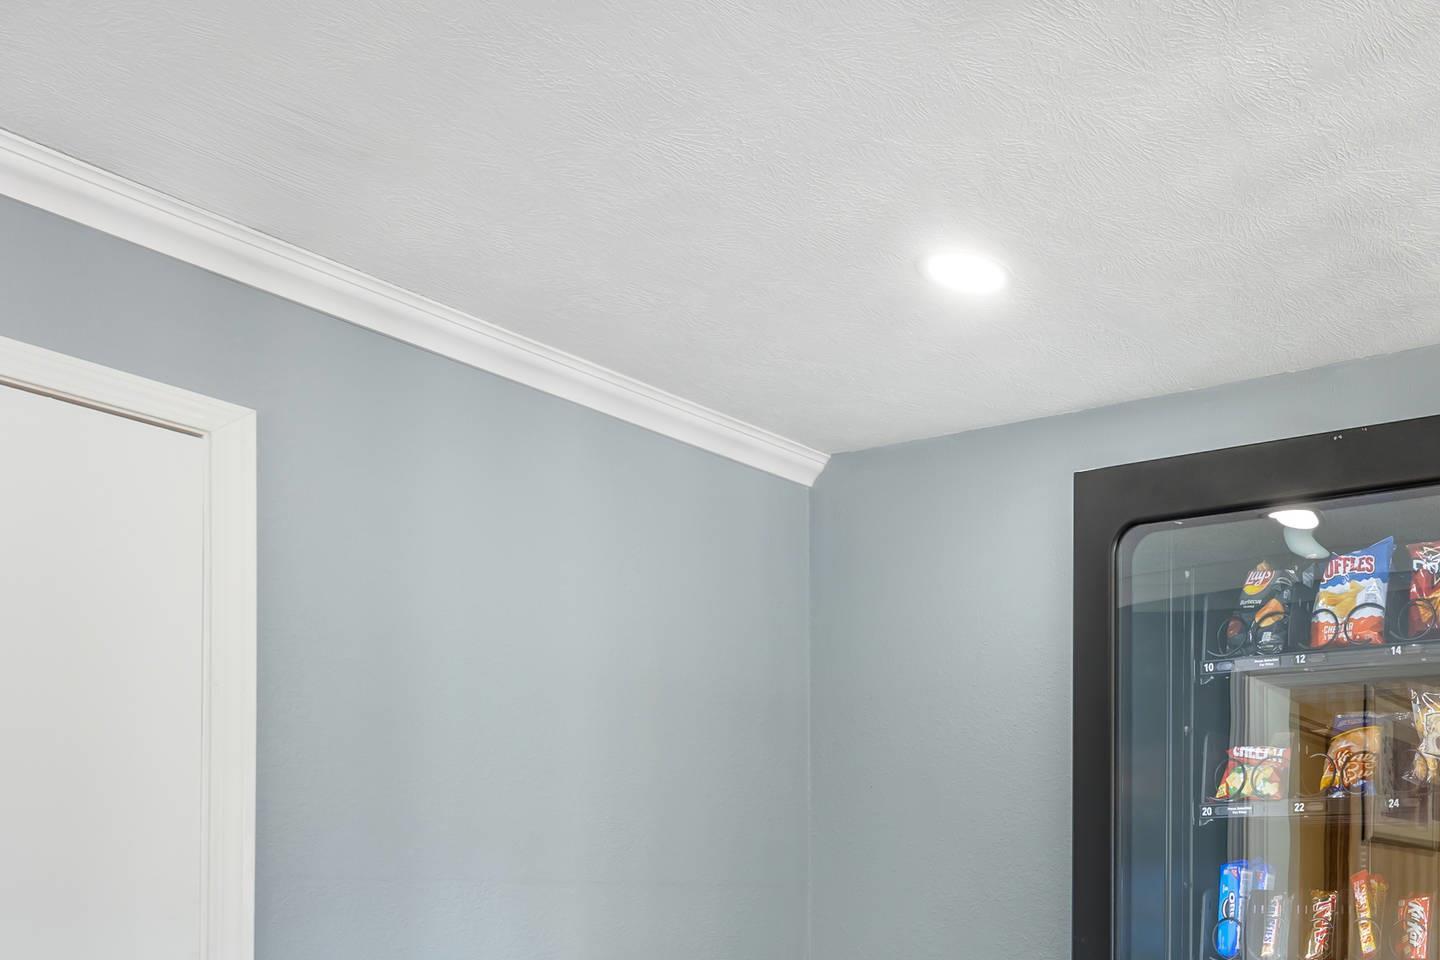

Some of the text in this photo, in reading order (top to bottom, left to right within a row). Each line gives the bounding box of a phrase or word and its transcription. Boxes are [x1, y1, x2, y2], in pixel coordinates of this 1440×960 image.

[1321, 555, 1376, 583] UFFLES
[1391, 646, 1402, 655] 14
[1295, 654, 1306, 664] 12
[1203, 662, 1214, 672] 10
[1294, 803, 1305, 812] 22
[1388, 798, 1399, 808] 24
[1202, 807, 1212, 817] 20
